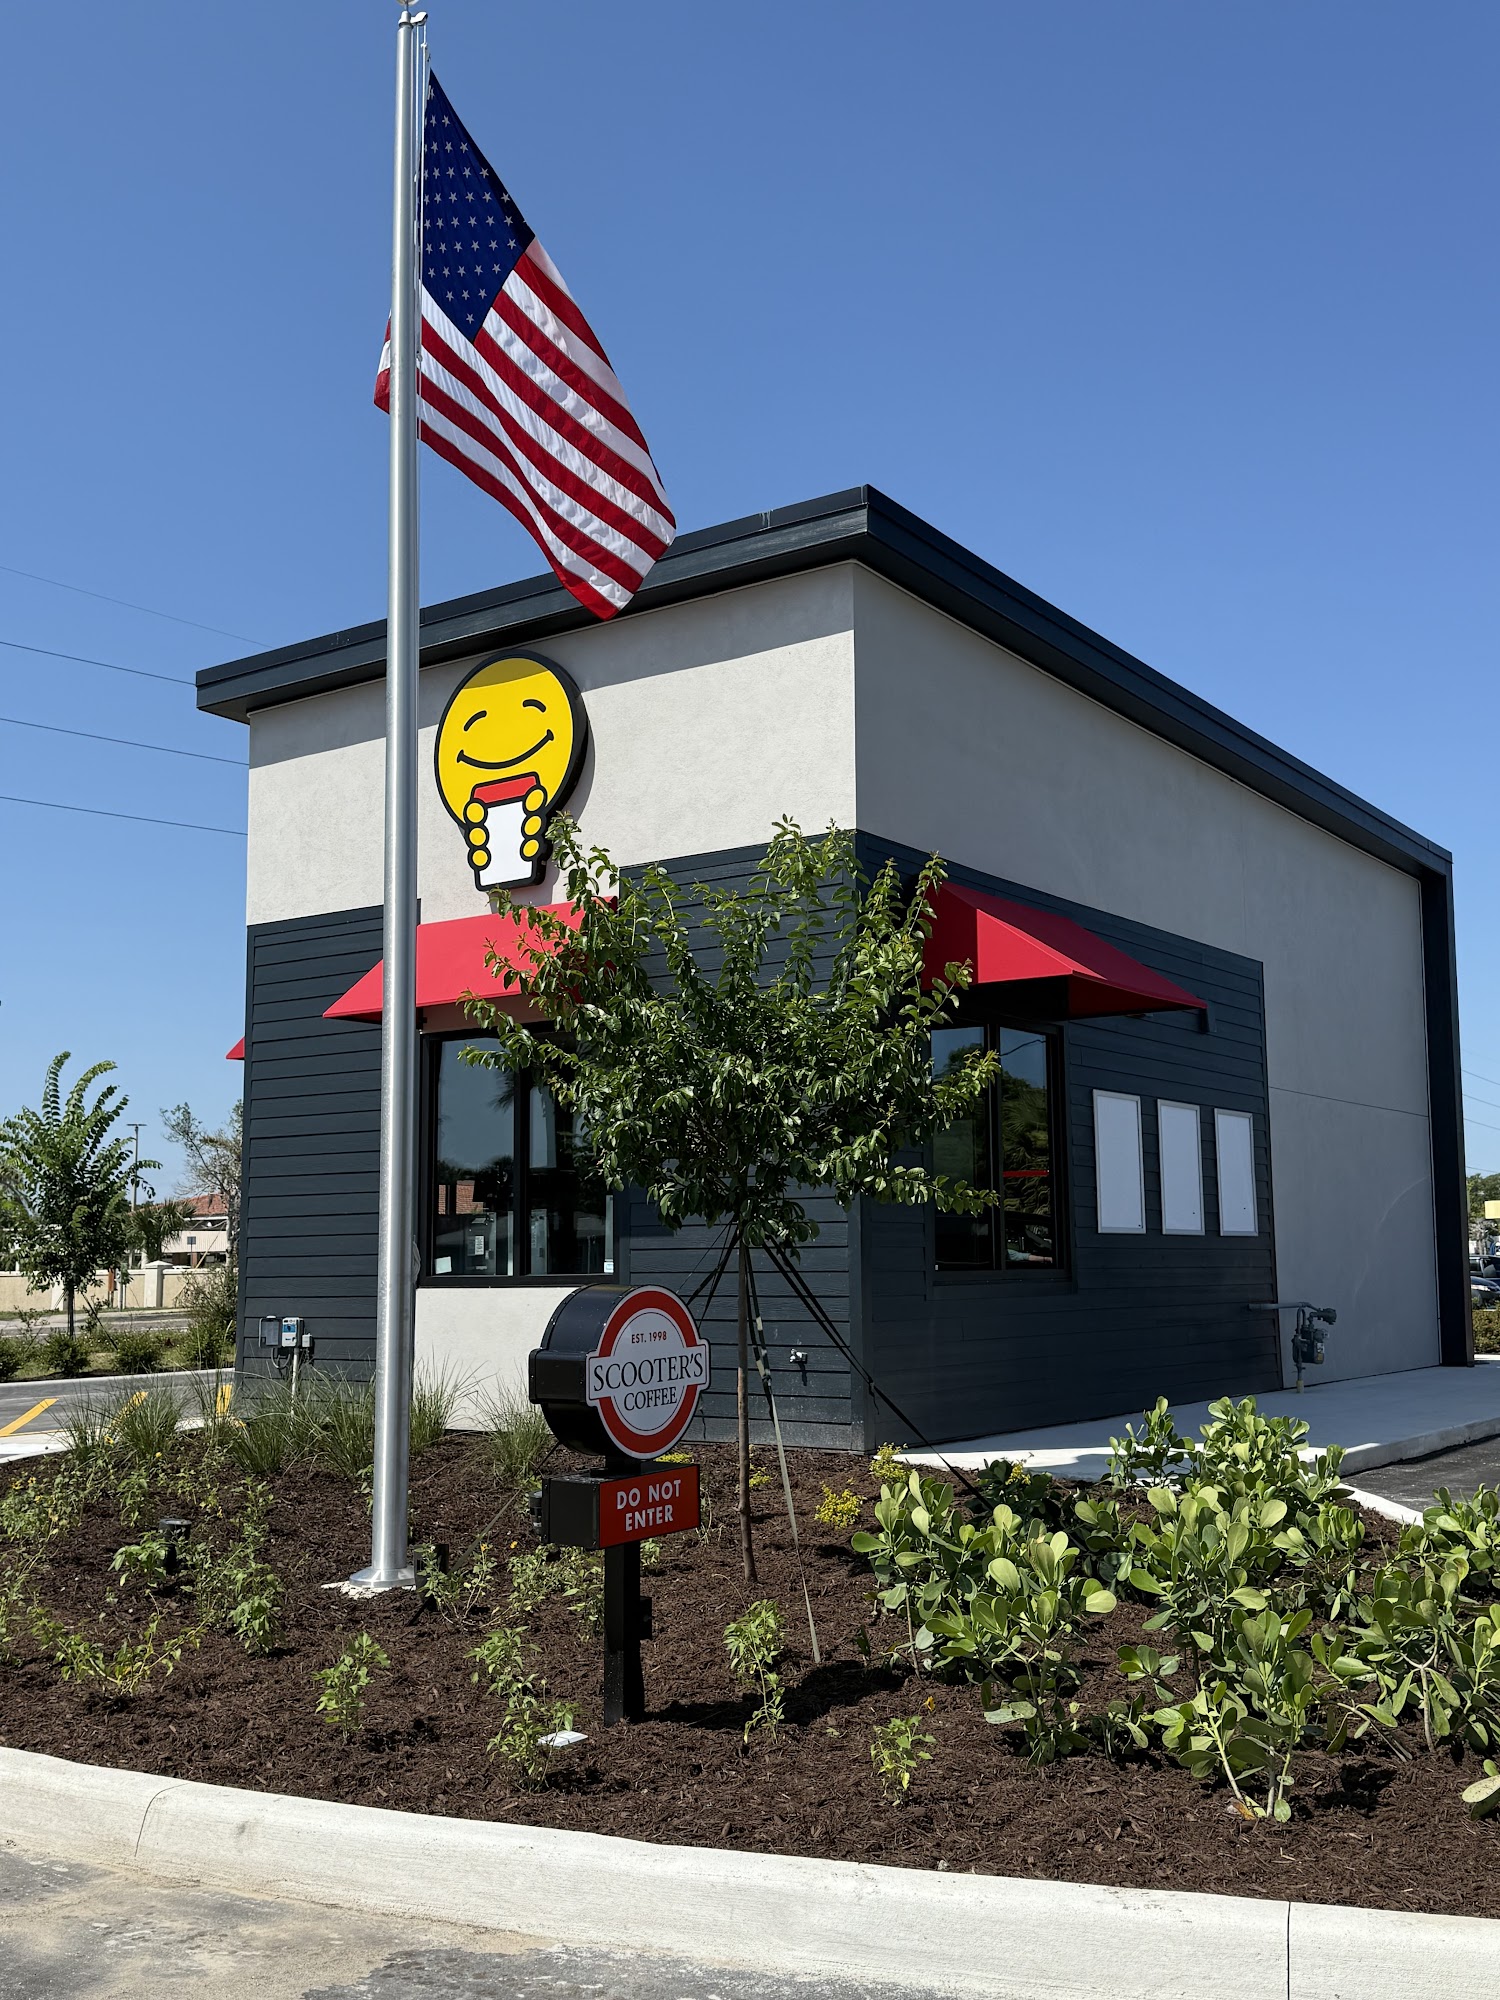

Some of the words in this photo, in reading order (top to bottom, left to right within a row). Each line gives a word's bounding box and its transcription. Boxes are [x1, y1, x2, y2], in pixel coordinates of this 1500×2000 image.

[631, 1332, 647, 1344] EST.
[649, 1330, 667, 1342] 1998
[593, 1353, 703, 1391] SCOOTER'S
[624, 1387, 677, 1411] COFFEE
[616, 1488, 641, 1510] DO
[648, 1479, 681, 1502] NOT
[626, 1505, 673, 1531] ENTER
